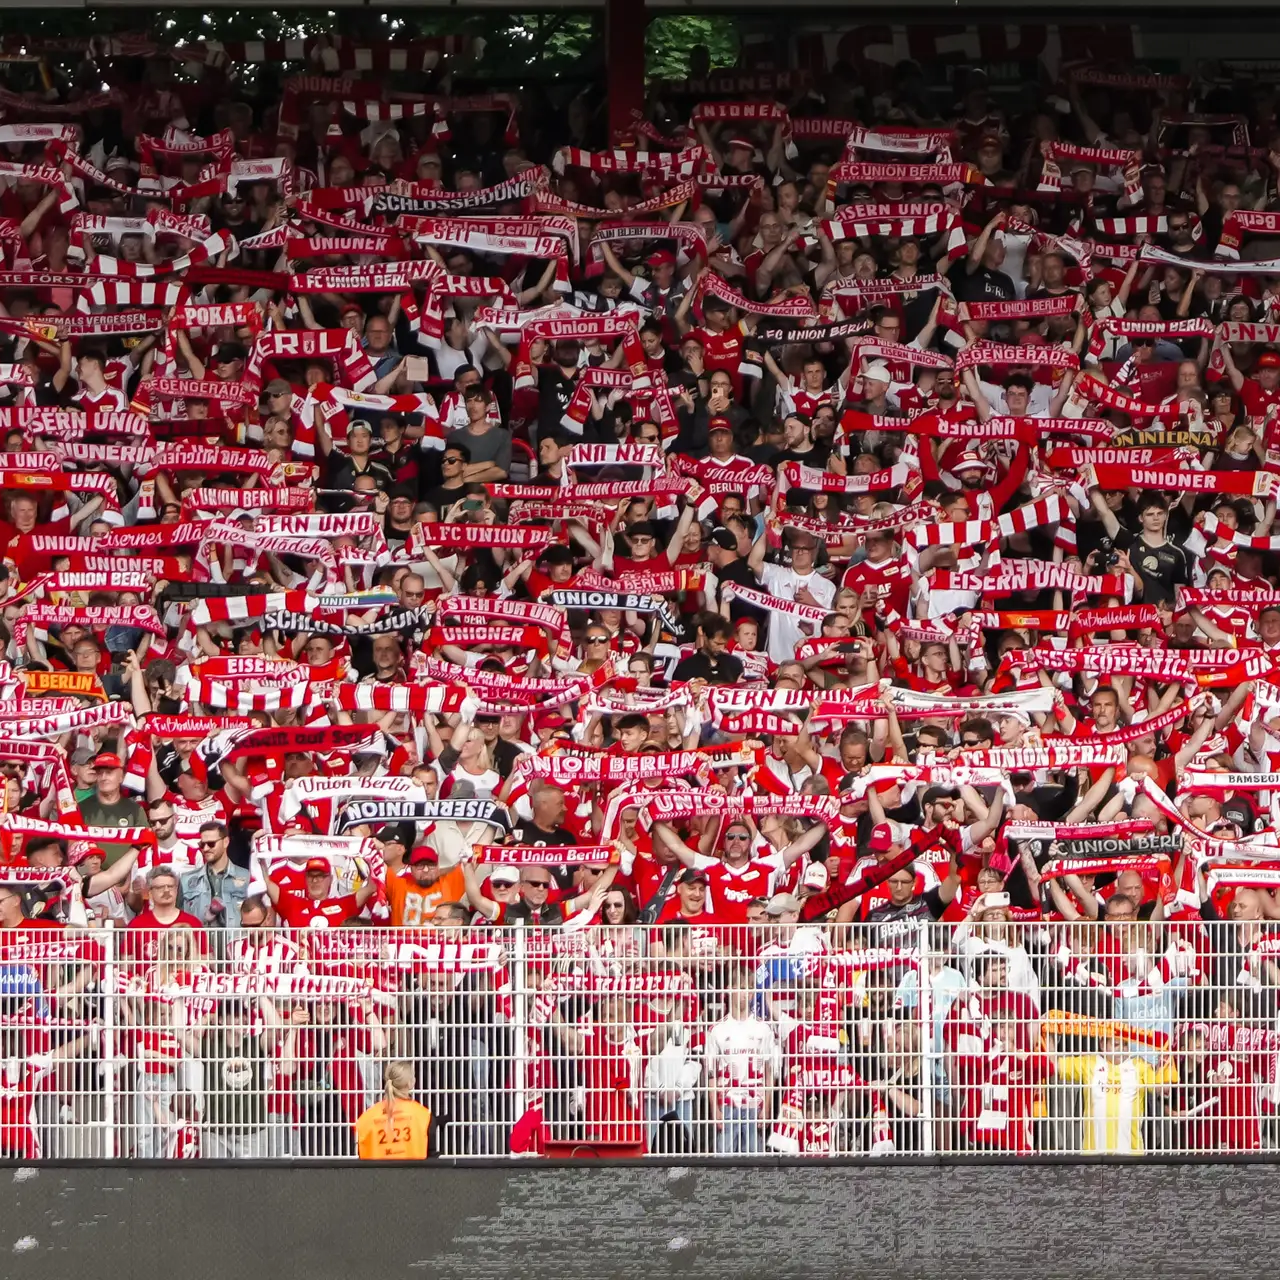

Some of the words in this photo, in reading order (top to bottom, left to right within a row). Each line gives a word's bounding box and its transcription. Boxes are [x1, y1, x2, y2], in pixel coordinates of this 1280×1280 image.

[841, 165, 859, 178] FC
[863, 165, 907, 179] UNION
[911, 165, 960, 179] BERLIN
[306, 276, 325, 289] FC
[328, 275, 370, 288] UNION
[186, 304, 247, 324] POKAL
[548, 320, 597, 335] Union
[788, 326, 827, 339] UNION
[1072, 450, 1151, 464] UNIONER
[1131, 470, 1215, 488] UNIONER
[494, 485, 510, 497] FC
[514, 483, 552, 497] Union
[559, 485, 573, 497] FC
[577, 481, 609, 495] UNION
[612, 478, 651, 494] BERLIN
[709, 483, 745, 494] BERLIN
[439, 527, 462, 543] FC
[465, 527, 526, 544] UNION
[85, 556, 163, 572] UNIONER
[59, 574, 108, 586] UNION
[322, 596, 359, 605] UNION
[447, 597, 490, 614] STEH
[554, 591, 619, 606] UNION
[443, 628, 524, 642] UNIONER
[41, 675, 93, 689] BERLIN
[20, 699, 75, 713] BERLIN
[298, 778, 356, 794] Union
[360, 778, 411, 792] Berlin
[1069, 838, 1129, 853] UNION
[485, 850, 495, 863] 1.
[498, 850, 516, 862] FC
[521, 849, 563, 862] Union
[567, 847, 609, 861] Berlin
